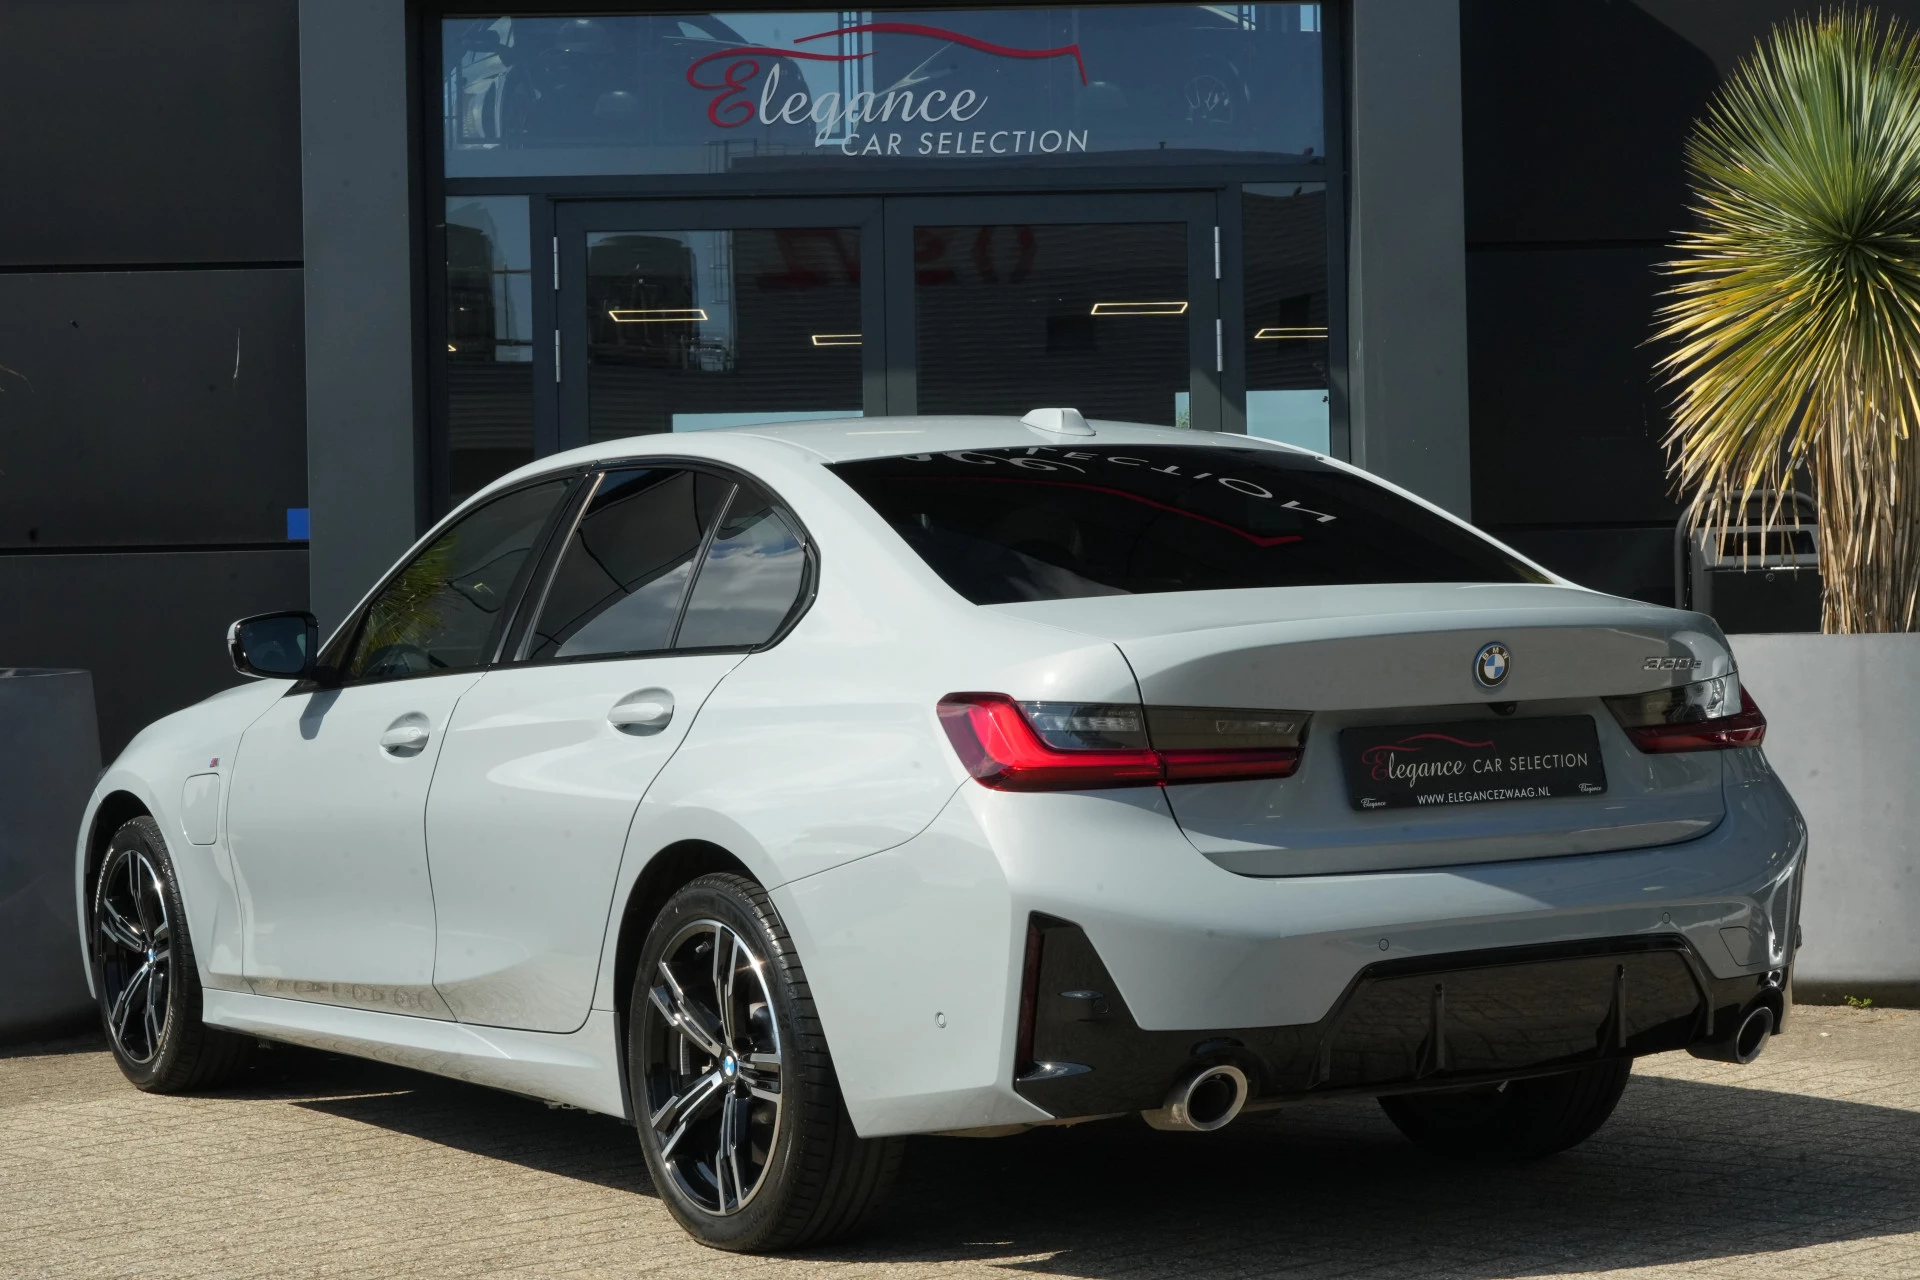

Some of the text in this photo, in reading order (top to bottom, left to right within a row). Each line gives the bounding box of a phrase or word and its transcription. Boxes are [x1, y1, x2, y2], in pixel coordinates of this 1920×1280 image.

[686, 47, 988, 147] Elegance
[841, 129, 1089, 156] CAR SELECTION
[1482, 647, 1509, 660] BMW
[1362, 745, 1588, 788] Elegance CAR SELECTION
[1417, 786, 1551, 805] WWW.ELEGANCEZWAAG.NL
